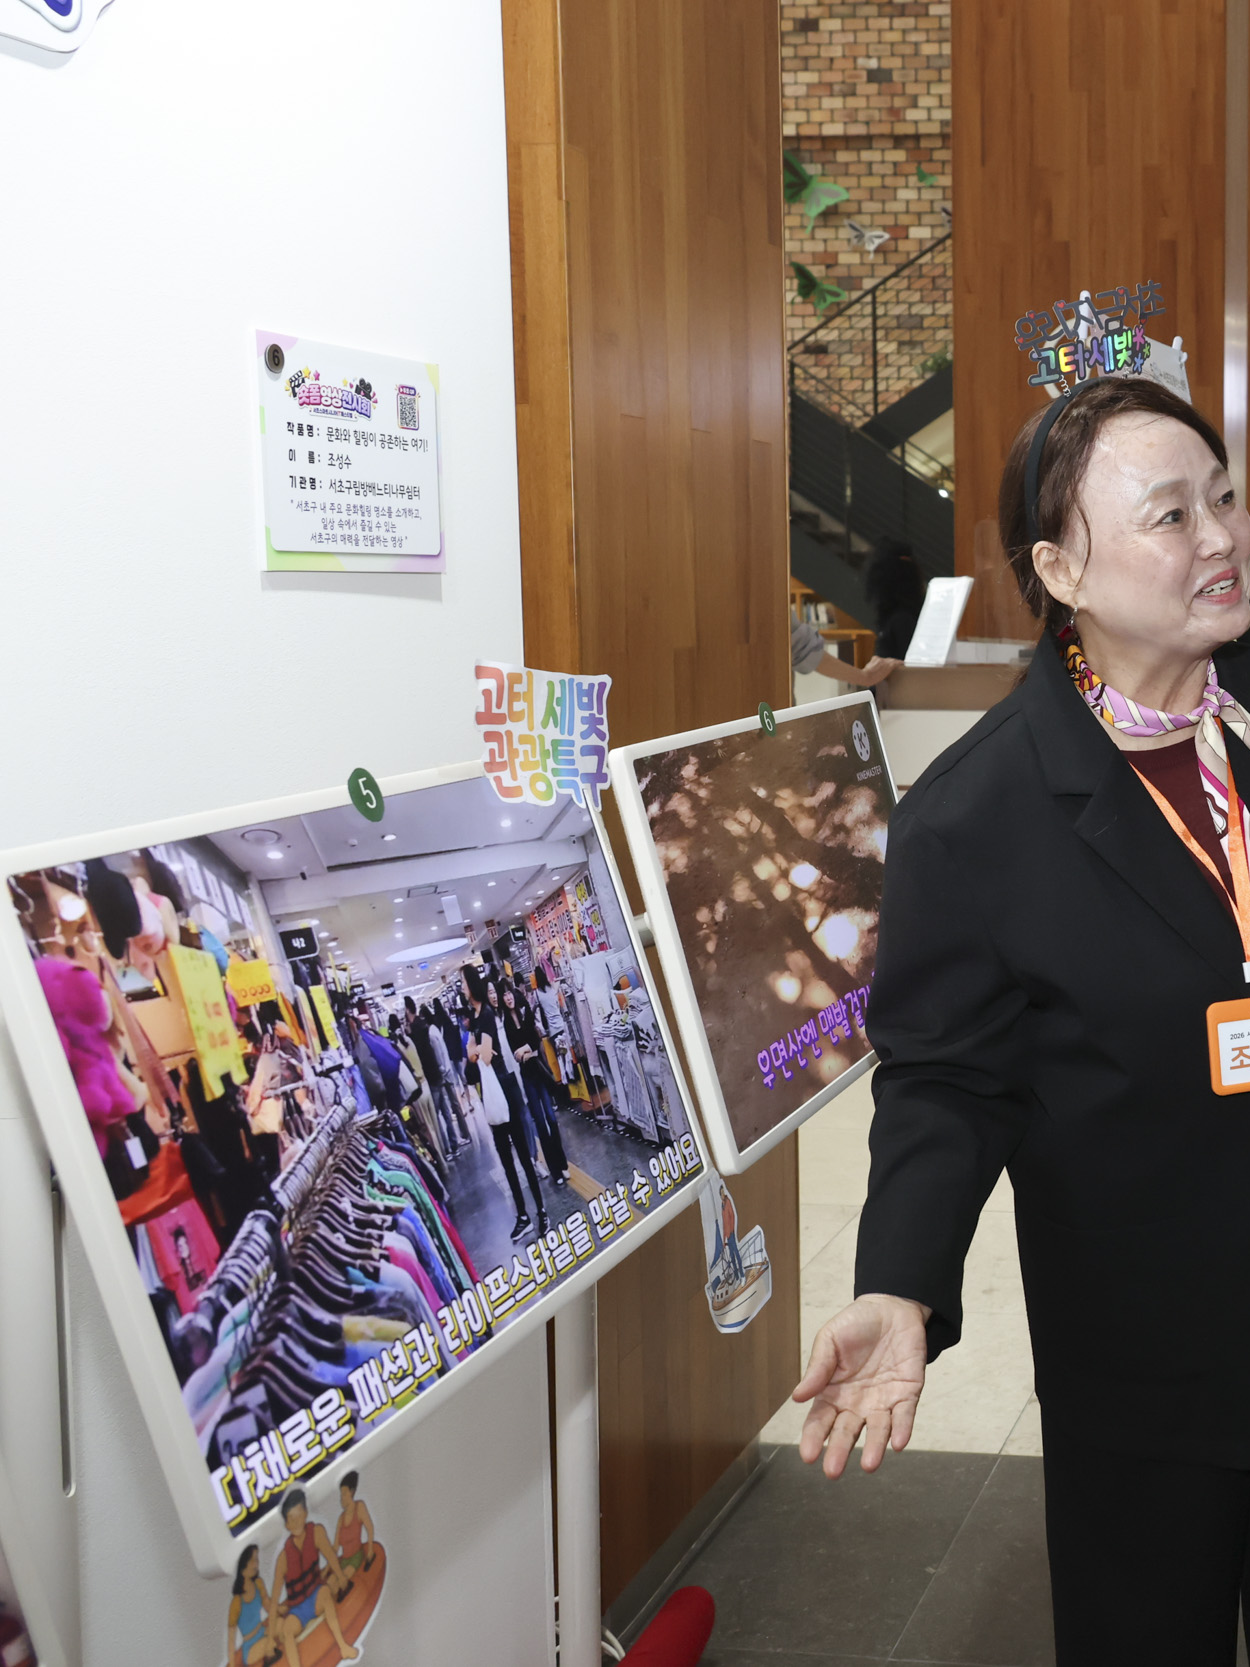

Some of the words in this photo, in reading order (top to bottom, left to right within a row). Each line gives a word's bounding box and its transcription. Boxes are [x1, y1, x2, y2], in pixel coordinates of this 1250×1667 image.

[273, 348, 280, 367] 6
[326, 427, 351, 443] 문화와
[353, 429, 377, 447] 힐링이
[379, 433, 409, 451] 공존하는
[411, 438, 429, 453] 여기!
[328, 453, 352, 469] 조성수
[763, 711, 773, 731] 6
[483, 730, 608, 808] 관광특구
[856, 765, 882, 782] KINEMASTER
[358, 776, 377, 809] 5
[210, 1387, 356, 1528] 다채로운
[348, 1322, 442, 1423] 패션과
[437, 1211, 595, 1355] 라이프스타일을
[588, 1181, 634, 1242] 만날
[630, 1168, 654, 1208] 수
[649, 1131, 703, 1196] 있어요
